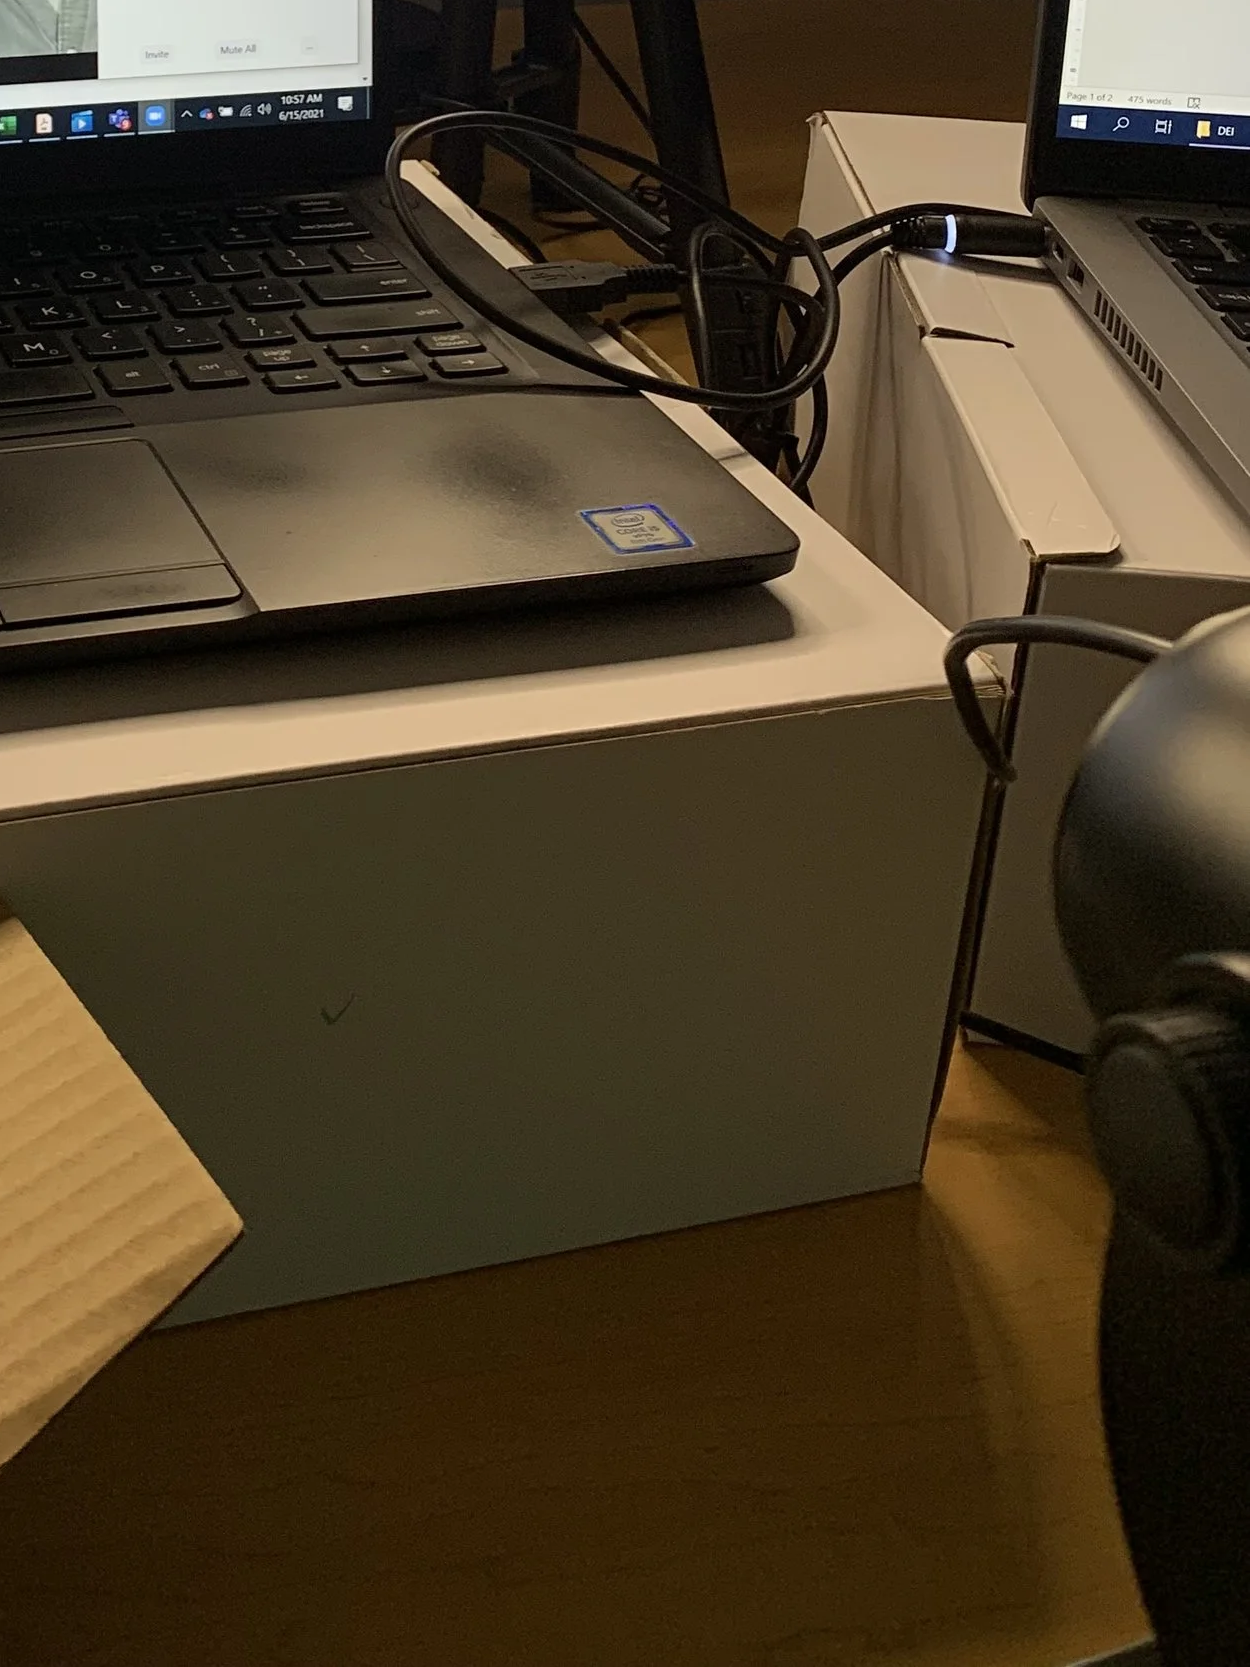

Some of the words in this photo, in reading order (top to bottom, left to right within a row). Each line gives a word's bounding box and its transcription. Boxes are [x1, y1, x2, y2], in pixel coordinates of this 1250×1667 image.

[144, 48, 170, 60] Invite
[219, 45, 243, 55] Mute
[244, 43, 257, 54] All
[280, 95, 305, 106] 10:57
[306, 93, 323, 104] AM
[1066, 91, 1087, 102] Page
[1096, 93, 1108, 103] of
[1108, 94, 1114, 103] 2
[1146, 95, 1172, 106] words
[278, 107, 325, 121] 6/15/2021
[1217, 125, 1235, 137] DEI
[150, 263, 166, 274] P
[78, 270, 98, 280] O
[115, 299, 132, 309] L
[41, 305, 59, 317] K
[22, 340, 46, 353] M
[197, 361, 221, 372] ctrl
[124, 369, 141, 379] alt
